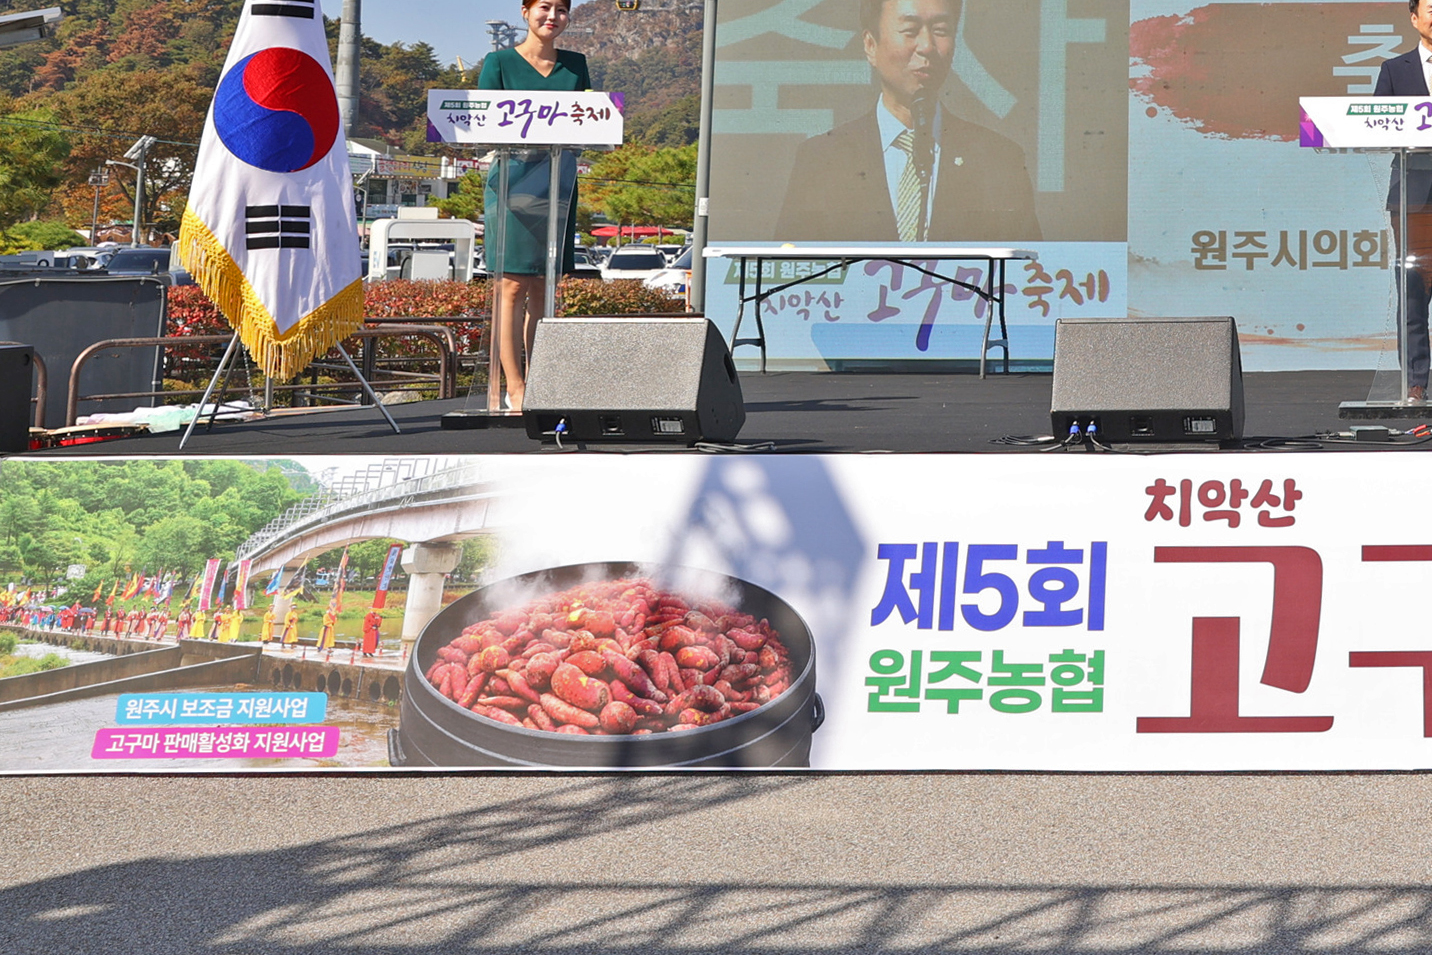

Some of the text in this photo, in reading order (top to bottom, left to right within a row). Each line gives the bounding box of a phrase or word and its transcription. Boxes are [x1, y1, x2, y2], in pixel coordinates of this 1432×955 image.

[446, 98, 611, 138] 치악산 고구마 축제
[1350, 104, 1404, 113] 제5회 원주농협
[1364, 117, 1404, 131] 치악산
[1190, 229, 1389, 271] 원주시의회
[1022, 259, 1111, 317] 축제
[1144, 477, 1303, 528] 치악산
[870, 540, 1108, 632] 제5회
[864, 648, 1105, 714] 원주농협
[125, 697, 308, 719] 원주시 보조금 지원사업
[105, 732, 325, 753] 고구마 판매활성화 지원사업
